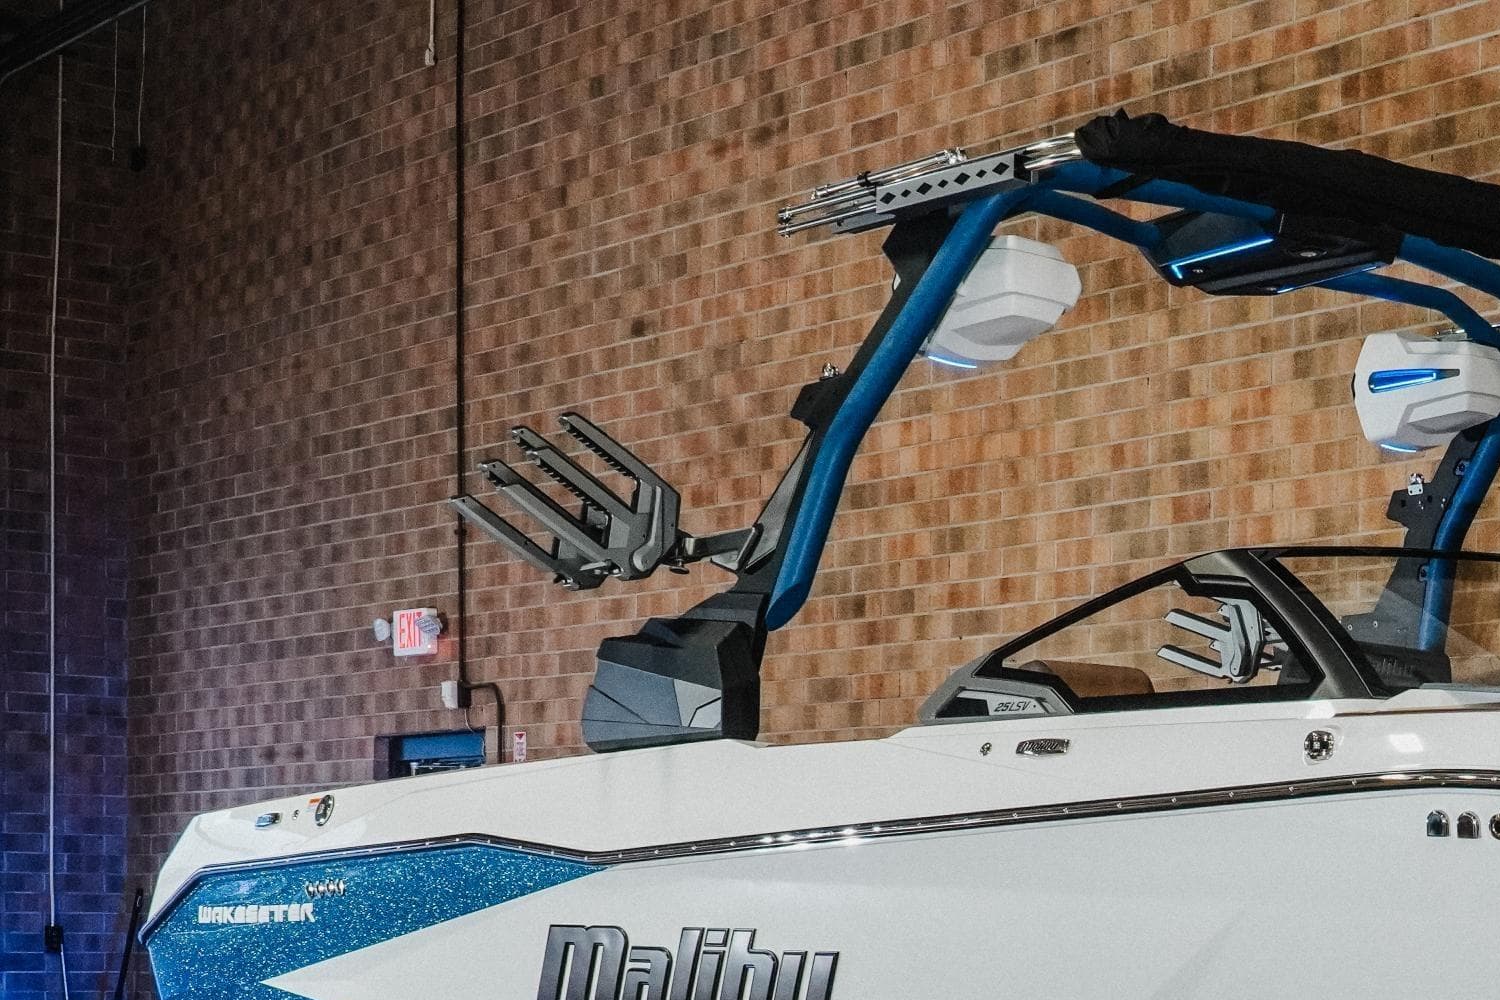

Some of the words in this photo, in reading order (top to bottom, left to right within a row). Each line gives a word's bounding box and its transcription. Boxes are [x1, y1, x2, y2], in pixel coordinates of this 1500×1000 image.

[399, 611, 422, 649] EXIT
[993, 701, 1032, 712] 25LSV
[198, 903, 316, 924] WAKESETTER
